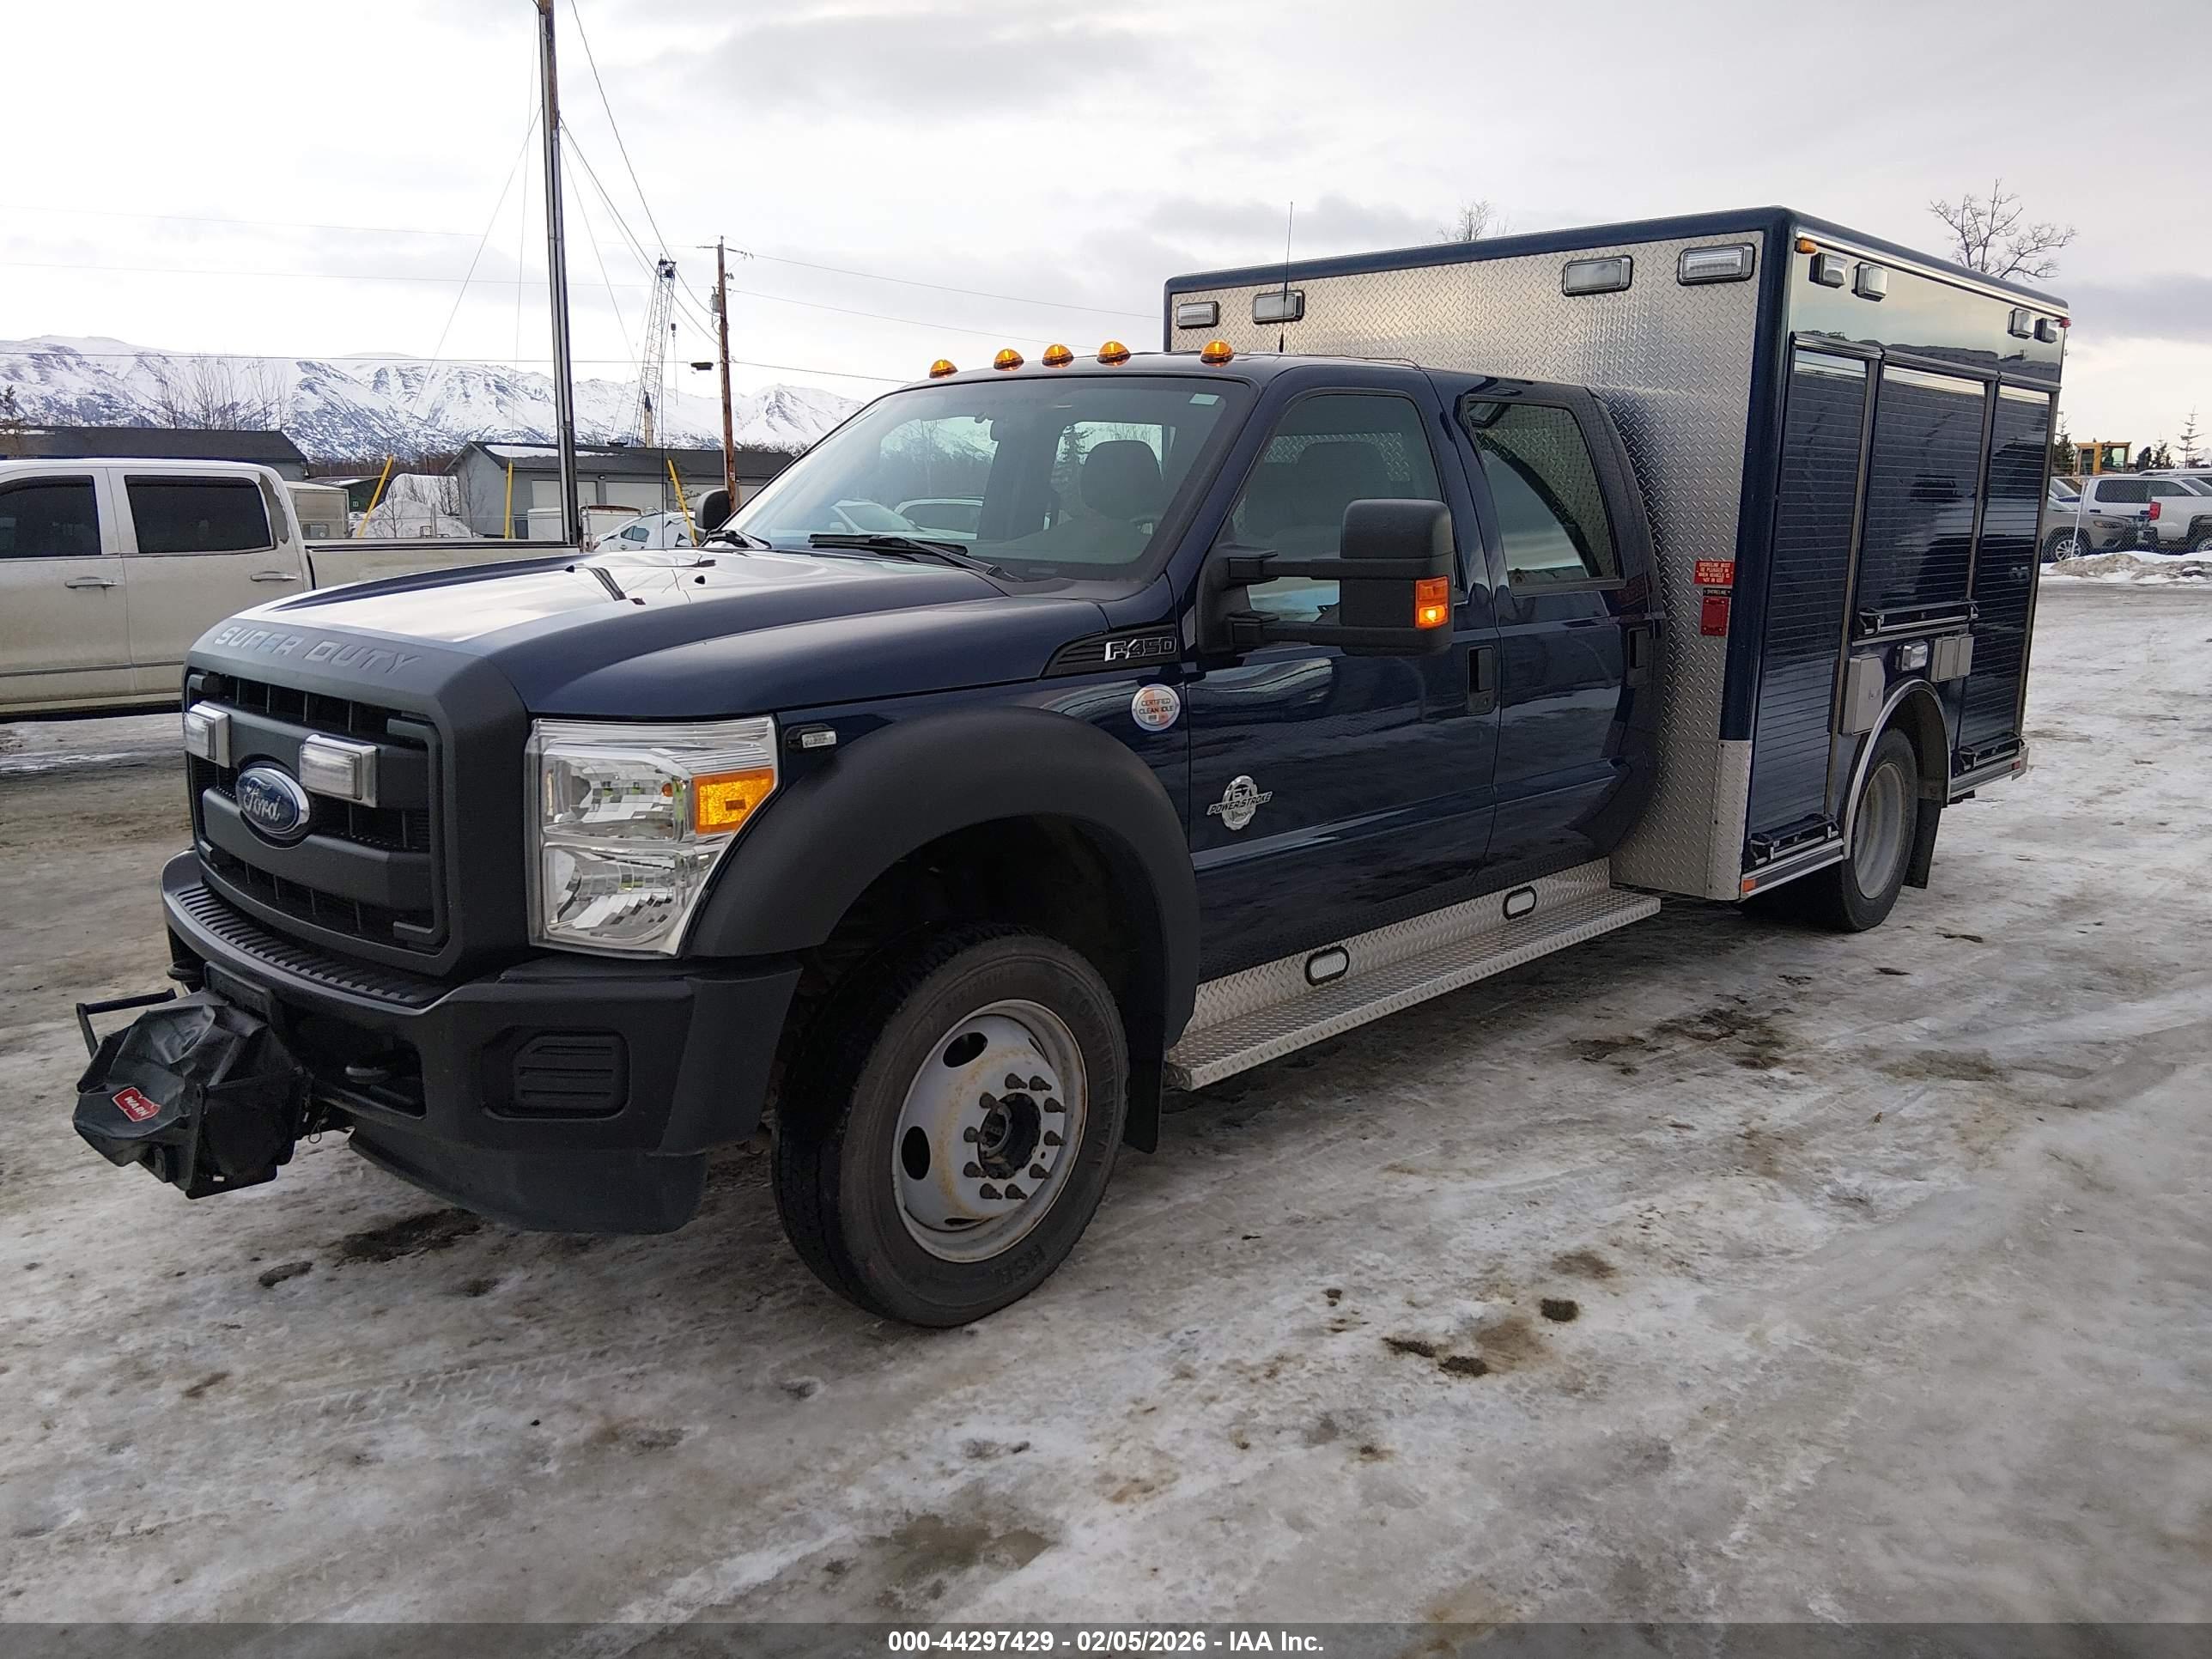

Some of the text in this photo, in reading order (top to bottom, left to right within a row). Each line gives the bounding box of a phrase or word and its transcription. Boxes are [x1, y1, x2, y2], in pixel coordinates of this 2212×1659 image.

[215, 626, 422, 674] SUPER DUTY
[1140, 698, 1171, 707] CERTIFIED
[244, 778, 282, 823] Ford
[125, 1096, 150, 1116] WARN
